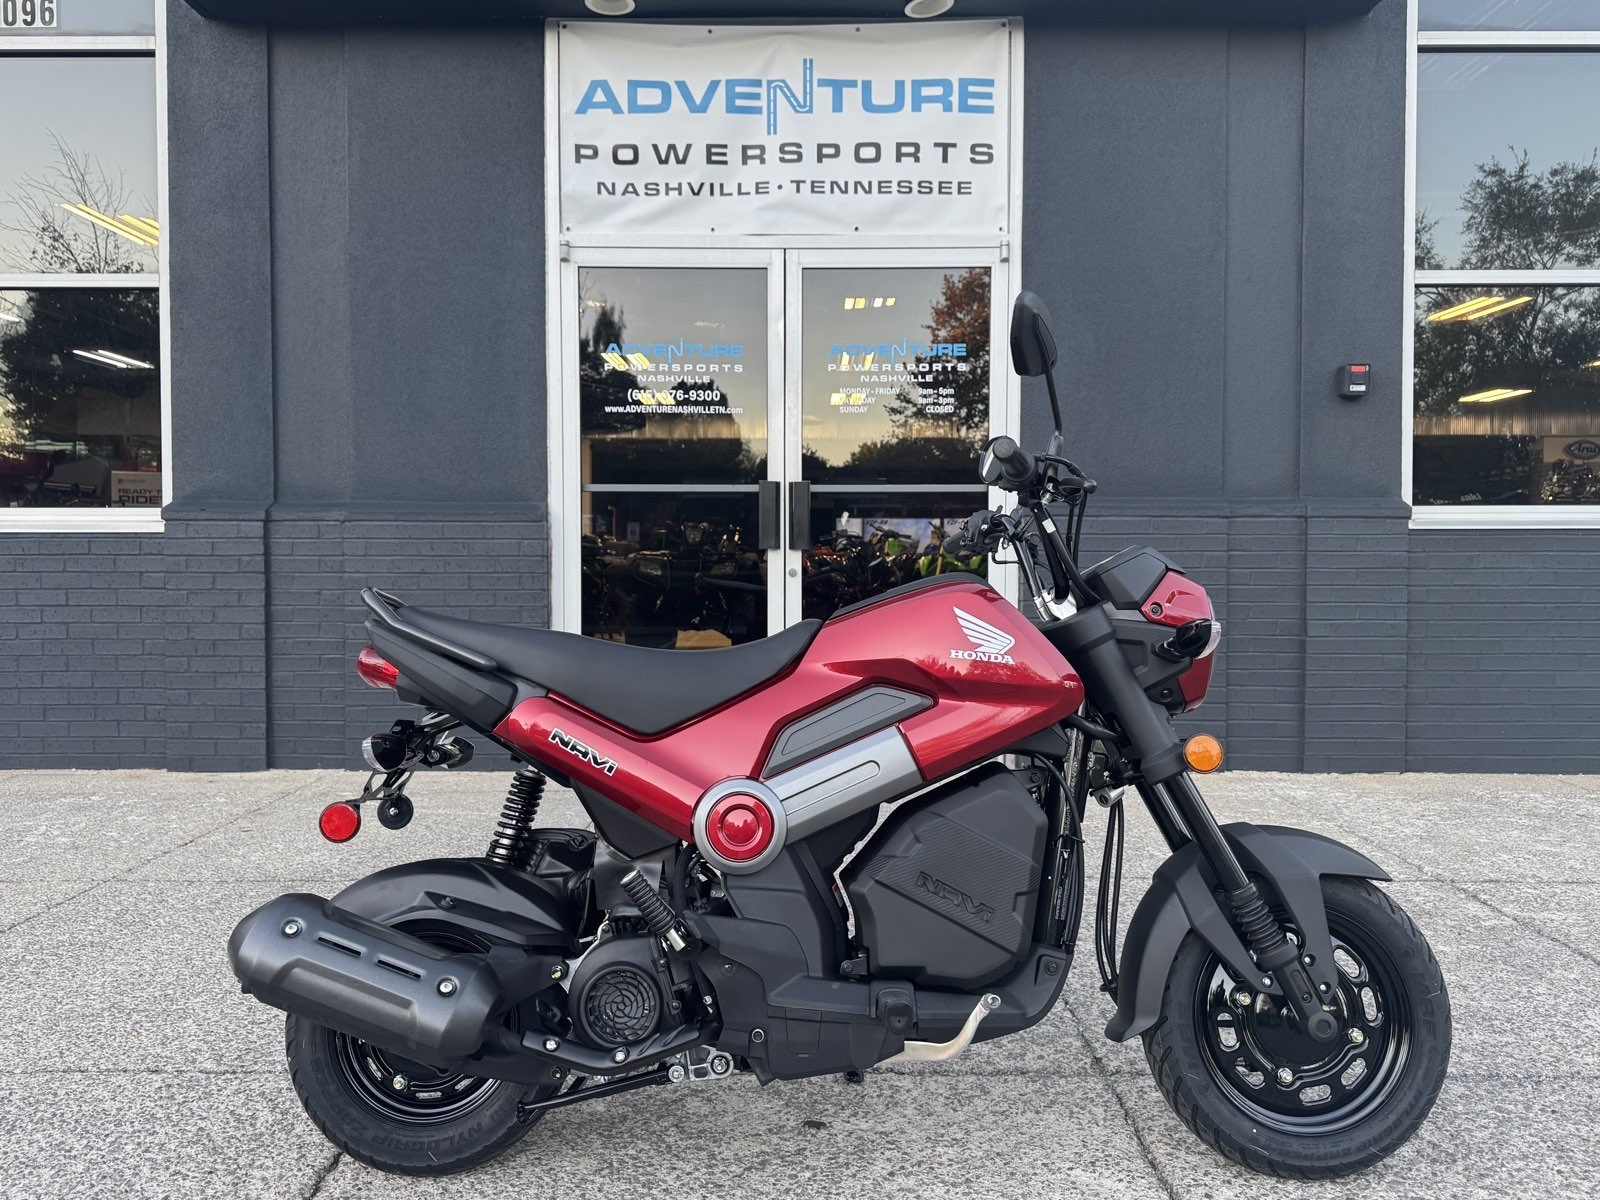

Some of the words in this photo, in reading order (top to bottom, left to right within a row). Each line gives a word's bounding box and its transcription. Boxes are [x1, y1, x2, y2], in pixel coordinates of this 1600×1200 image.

[3, 0, 55, 26] 096
[574, 58, 995, 135] ADVENTURE
[574, 141, 995, 165] POWERSPORTS
[597, 181, 770, 197] NASHVILLE
[790, 179, 973, 195] TENNESSEE
[605, 337, 744, 362] ADVENTURE
[829, 337, 967, 362] ADVENTURE
[637, 374, 711, 383] NASHVILLE
[860, 374, 934, 382] NASHVILLE
[875, 387, 901, 395] FRIDAY
[604, 405, 743, 414] www.ADVENTURENASHVILLETN.com
[925, 405, 955, 413] CLOSED
[119, 495, 161, 504] RIDE
[949, 649, 1016, 665] HONDA
